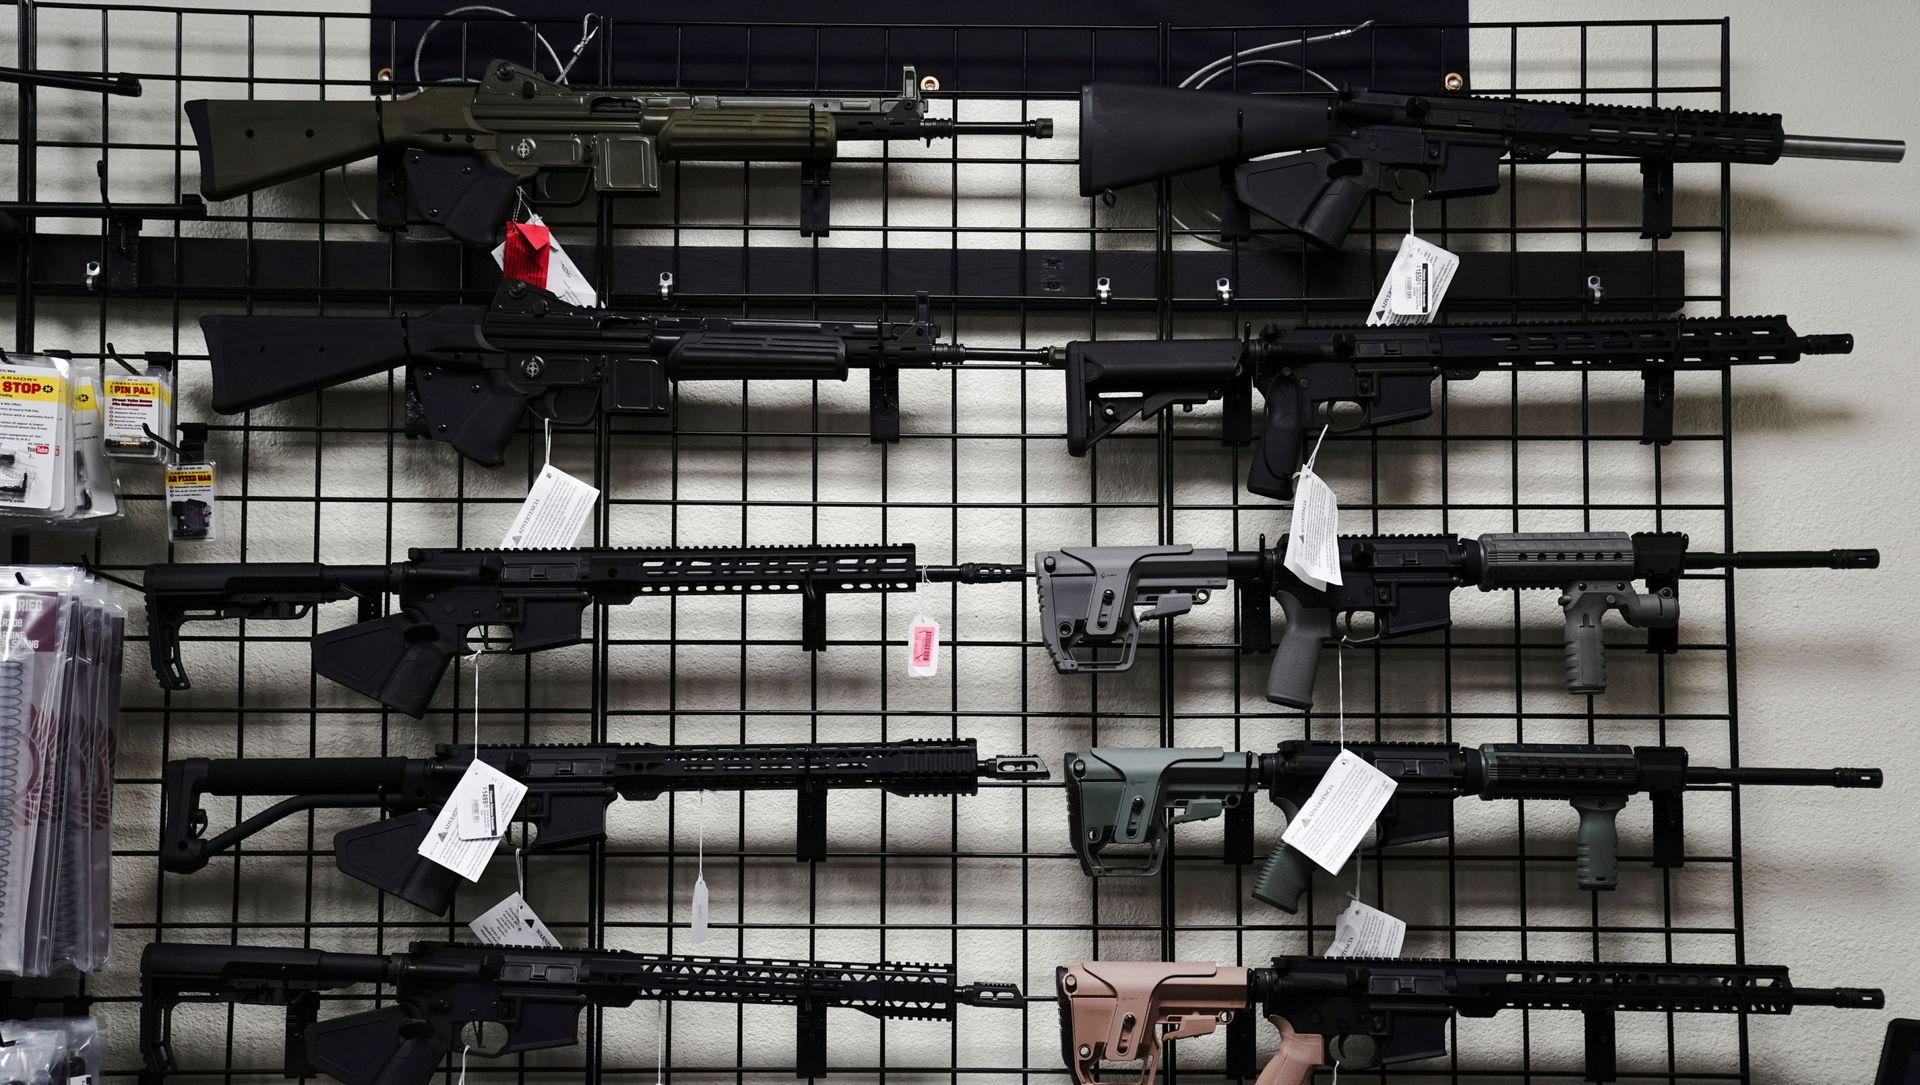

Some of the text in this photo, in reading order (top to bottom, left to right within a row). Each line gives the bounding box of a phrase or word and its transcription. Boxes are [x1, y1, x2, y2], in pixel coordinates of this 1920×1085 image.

[2, 381, 42, 394] STOP
[114, 385, 131, 394] PIN
[133, 387, 151, 395] PAL
